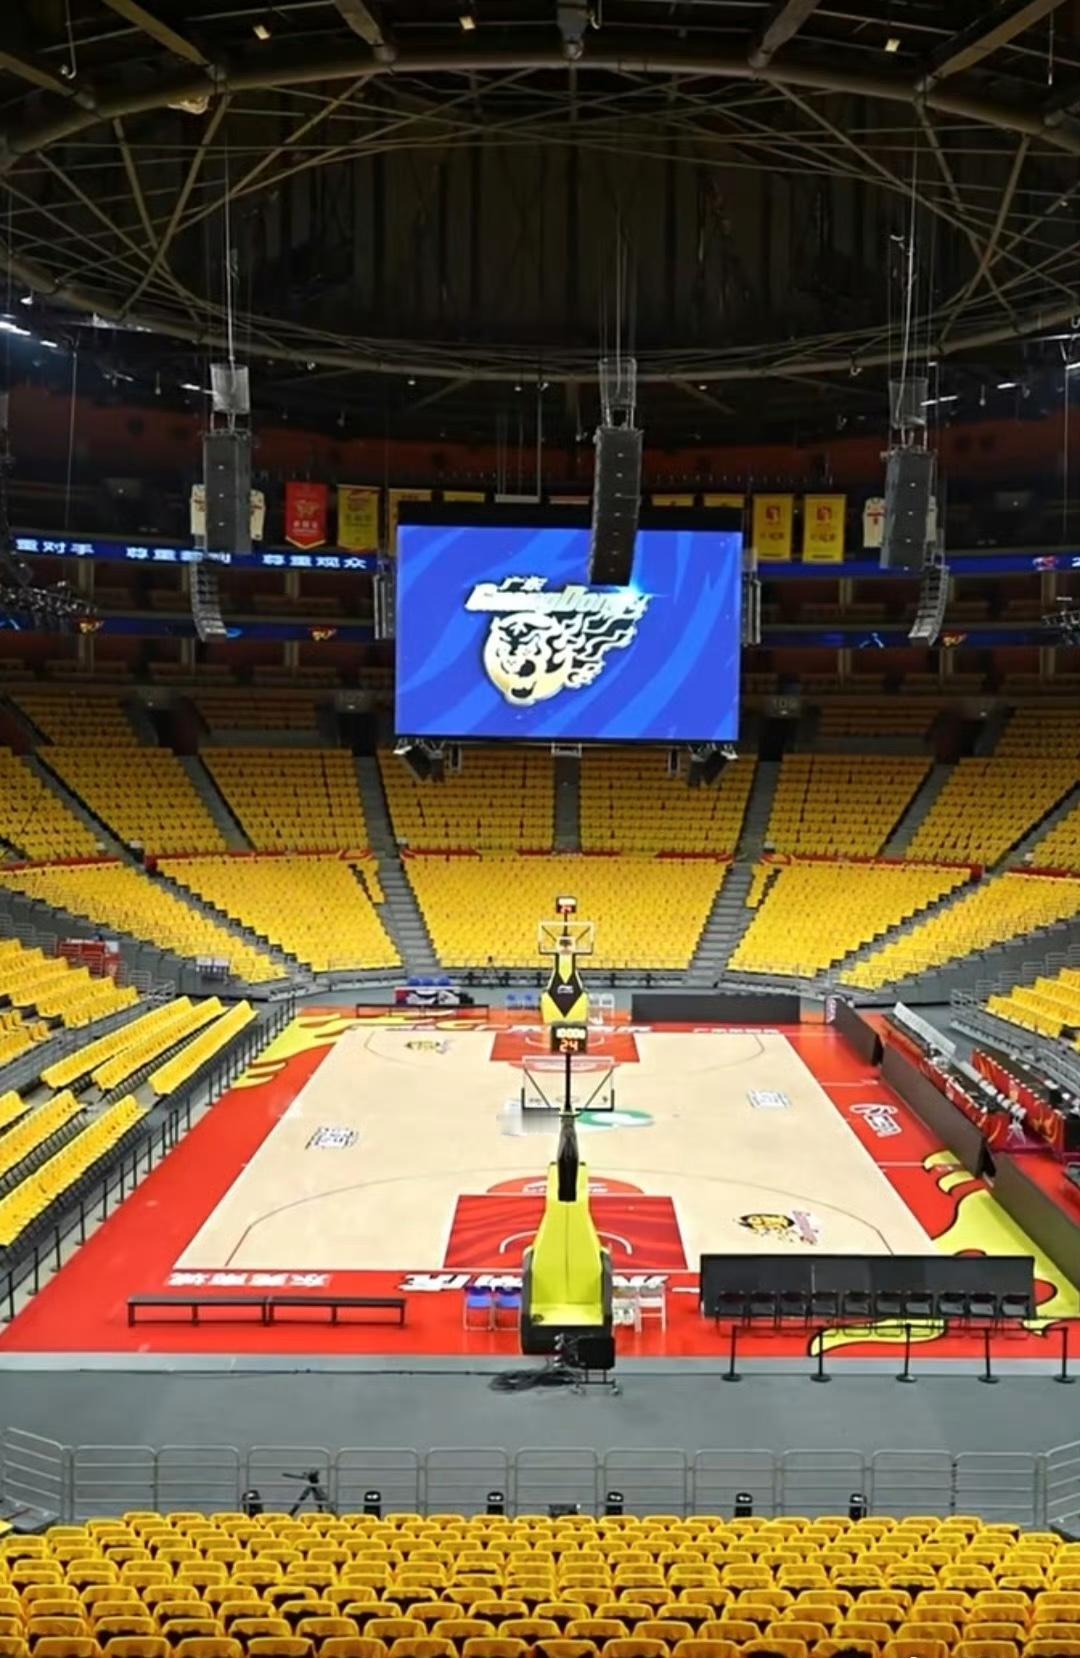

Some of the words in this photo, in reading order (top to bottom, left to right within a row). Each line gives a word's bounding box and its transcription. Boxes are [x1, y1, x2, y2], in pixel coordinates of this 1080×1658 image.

[263, 555, 367, 569] 尊重观众
[560, 1039, 578, 1052] 24
